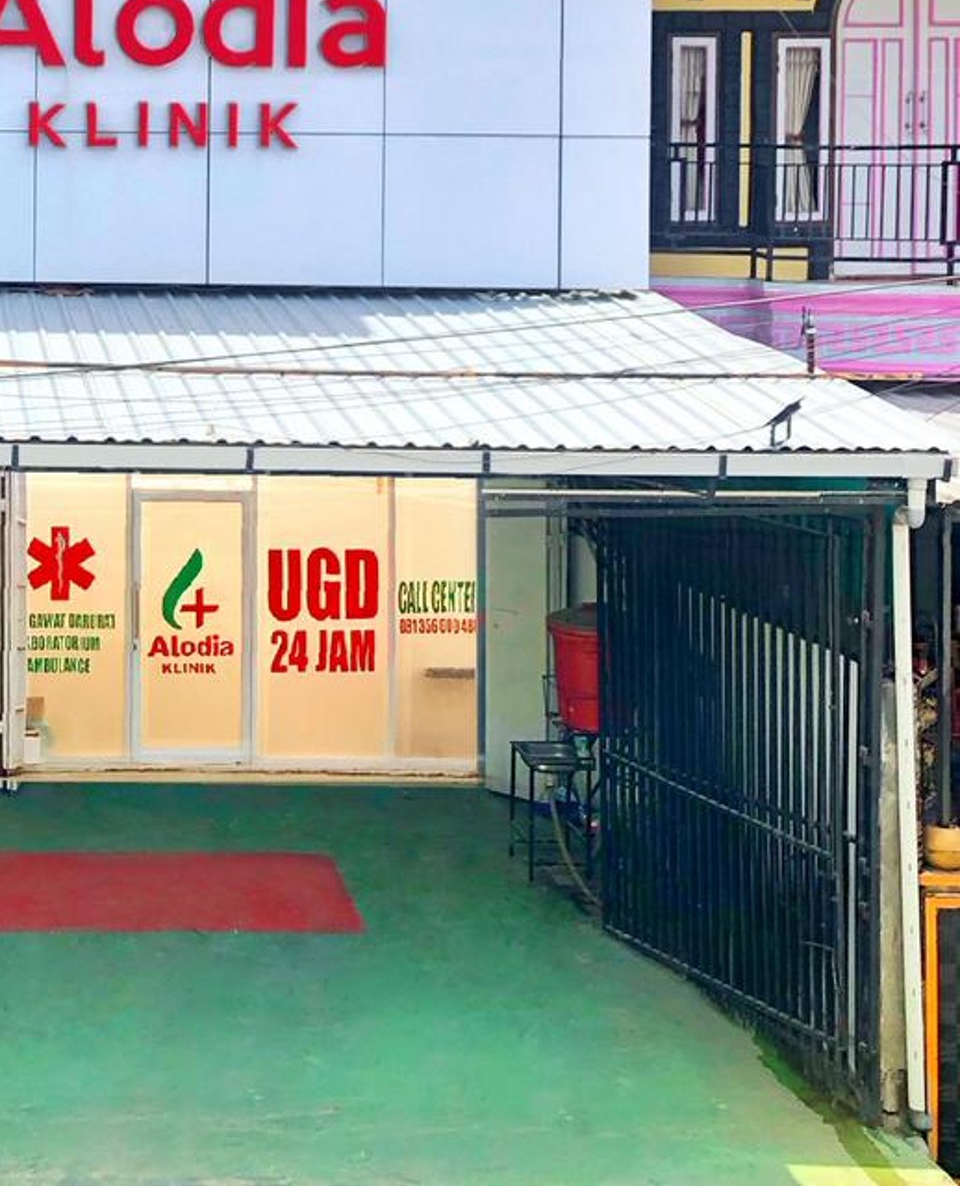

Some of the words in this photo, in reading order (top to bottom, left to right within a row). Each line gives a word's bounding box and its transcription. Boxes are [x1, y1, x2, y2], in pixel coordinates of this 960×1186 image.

[27, 101, 298, 148] KLINIK
[268, 547, 379, 621] UGD
[398, 581, 428, 613] CALL
[29, 613, 65, 628] GAWAT
[147, 634, 234, 657] Alodia
[270, 629, 308, 673] 24
[315, 630, 374, 672] JAM
[27, 657, 90, 673] AMBULANCE
[161, 662, 216, 674] KLINIK
